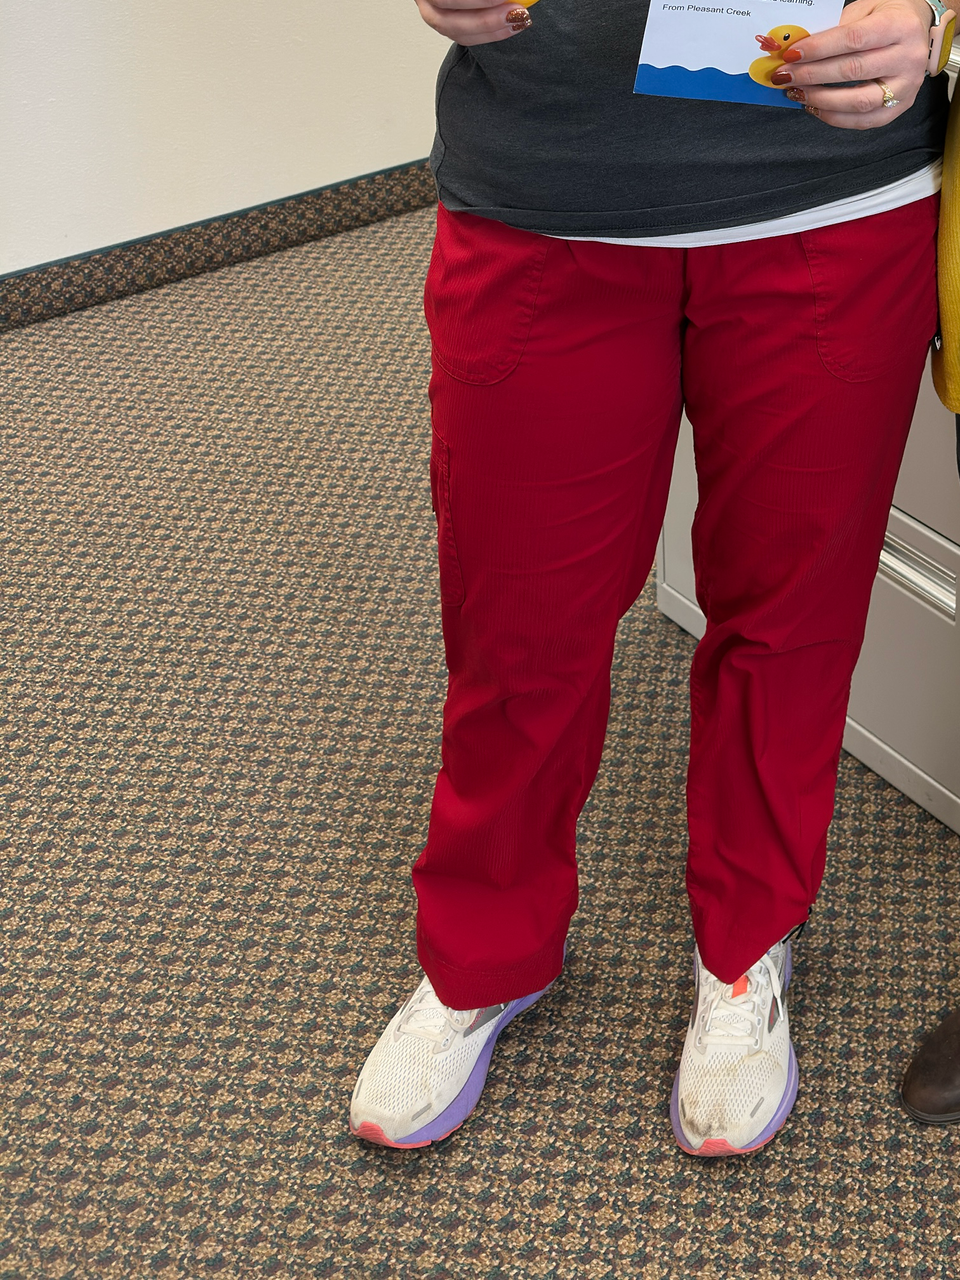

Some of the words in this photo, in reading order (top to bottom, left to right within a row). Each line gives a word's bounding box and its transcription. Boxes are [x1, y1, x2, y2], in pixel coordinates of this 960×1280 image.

[662, 3, 685, 12] From
[687, 4, 724, 14] Pleasant
[726, 7, 752, 17] Creek
